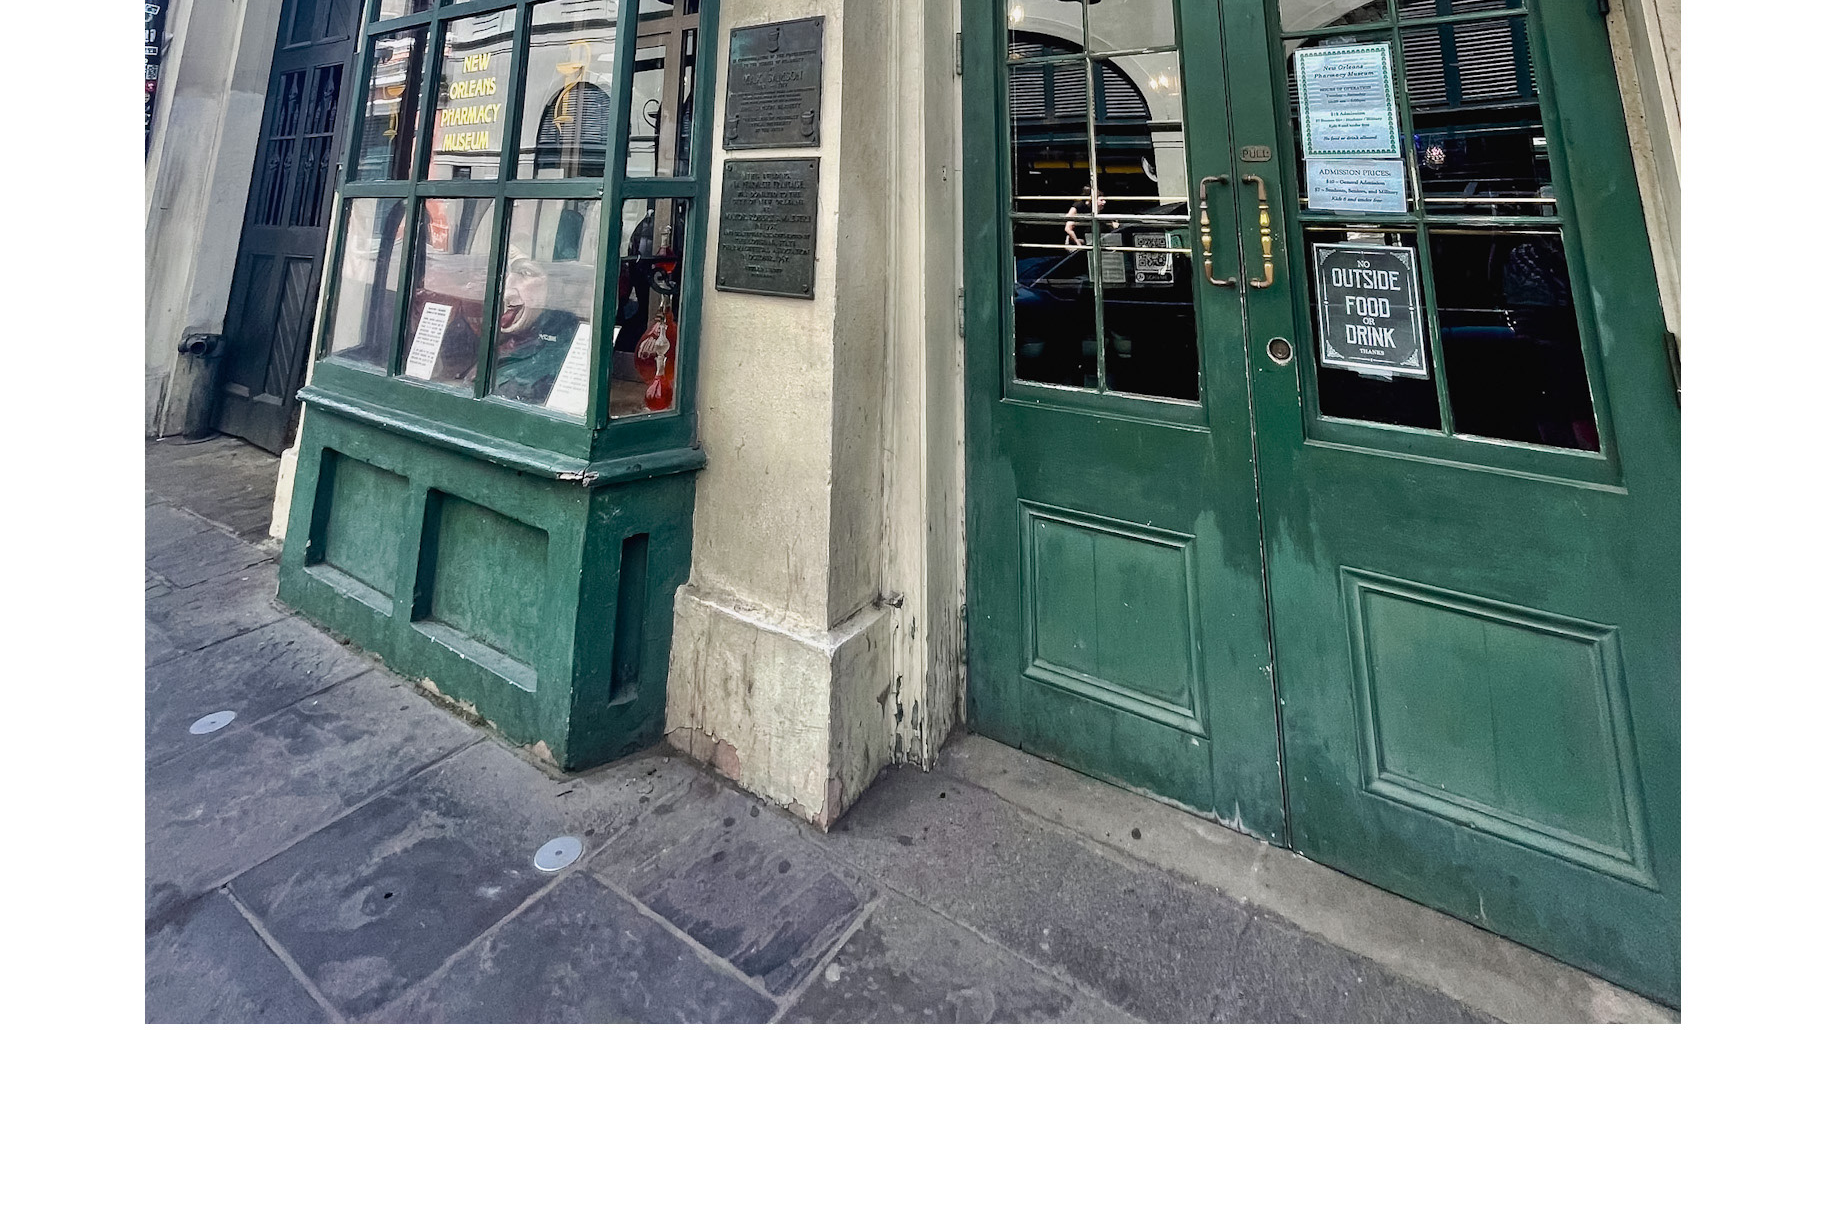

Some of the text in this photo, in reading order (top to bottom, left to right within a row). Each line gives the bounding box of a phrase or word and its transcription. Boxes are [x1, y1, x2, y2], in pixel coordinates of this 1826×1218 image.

[463, 53, 492, 74] NEW
[1323, 64, 1337, 72] New
[1314, 72, 1346, 80] Pharmacy
[449, 77, 497, 100] ORLEANS
[440, 103, 502, 127] PHARMACY
[442, 131, 489, 153] MUSEUM
[1242, 149, 1270, 159] PULL
[1319, 168, 1361, 176] ADMISSION
[1356, 260, 1371, 269] NO
[1331, 267, 1402, 291] OUTSIDE
[1345, 295, 1391, 318] FOOD
[1362, 317, 1376, 325] OR
[1345, 324, 1397, 349] DRINK
[1359, 348, 1385, 356] THANKS
